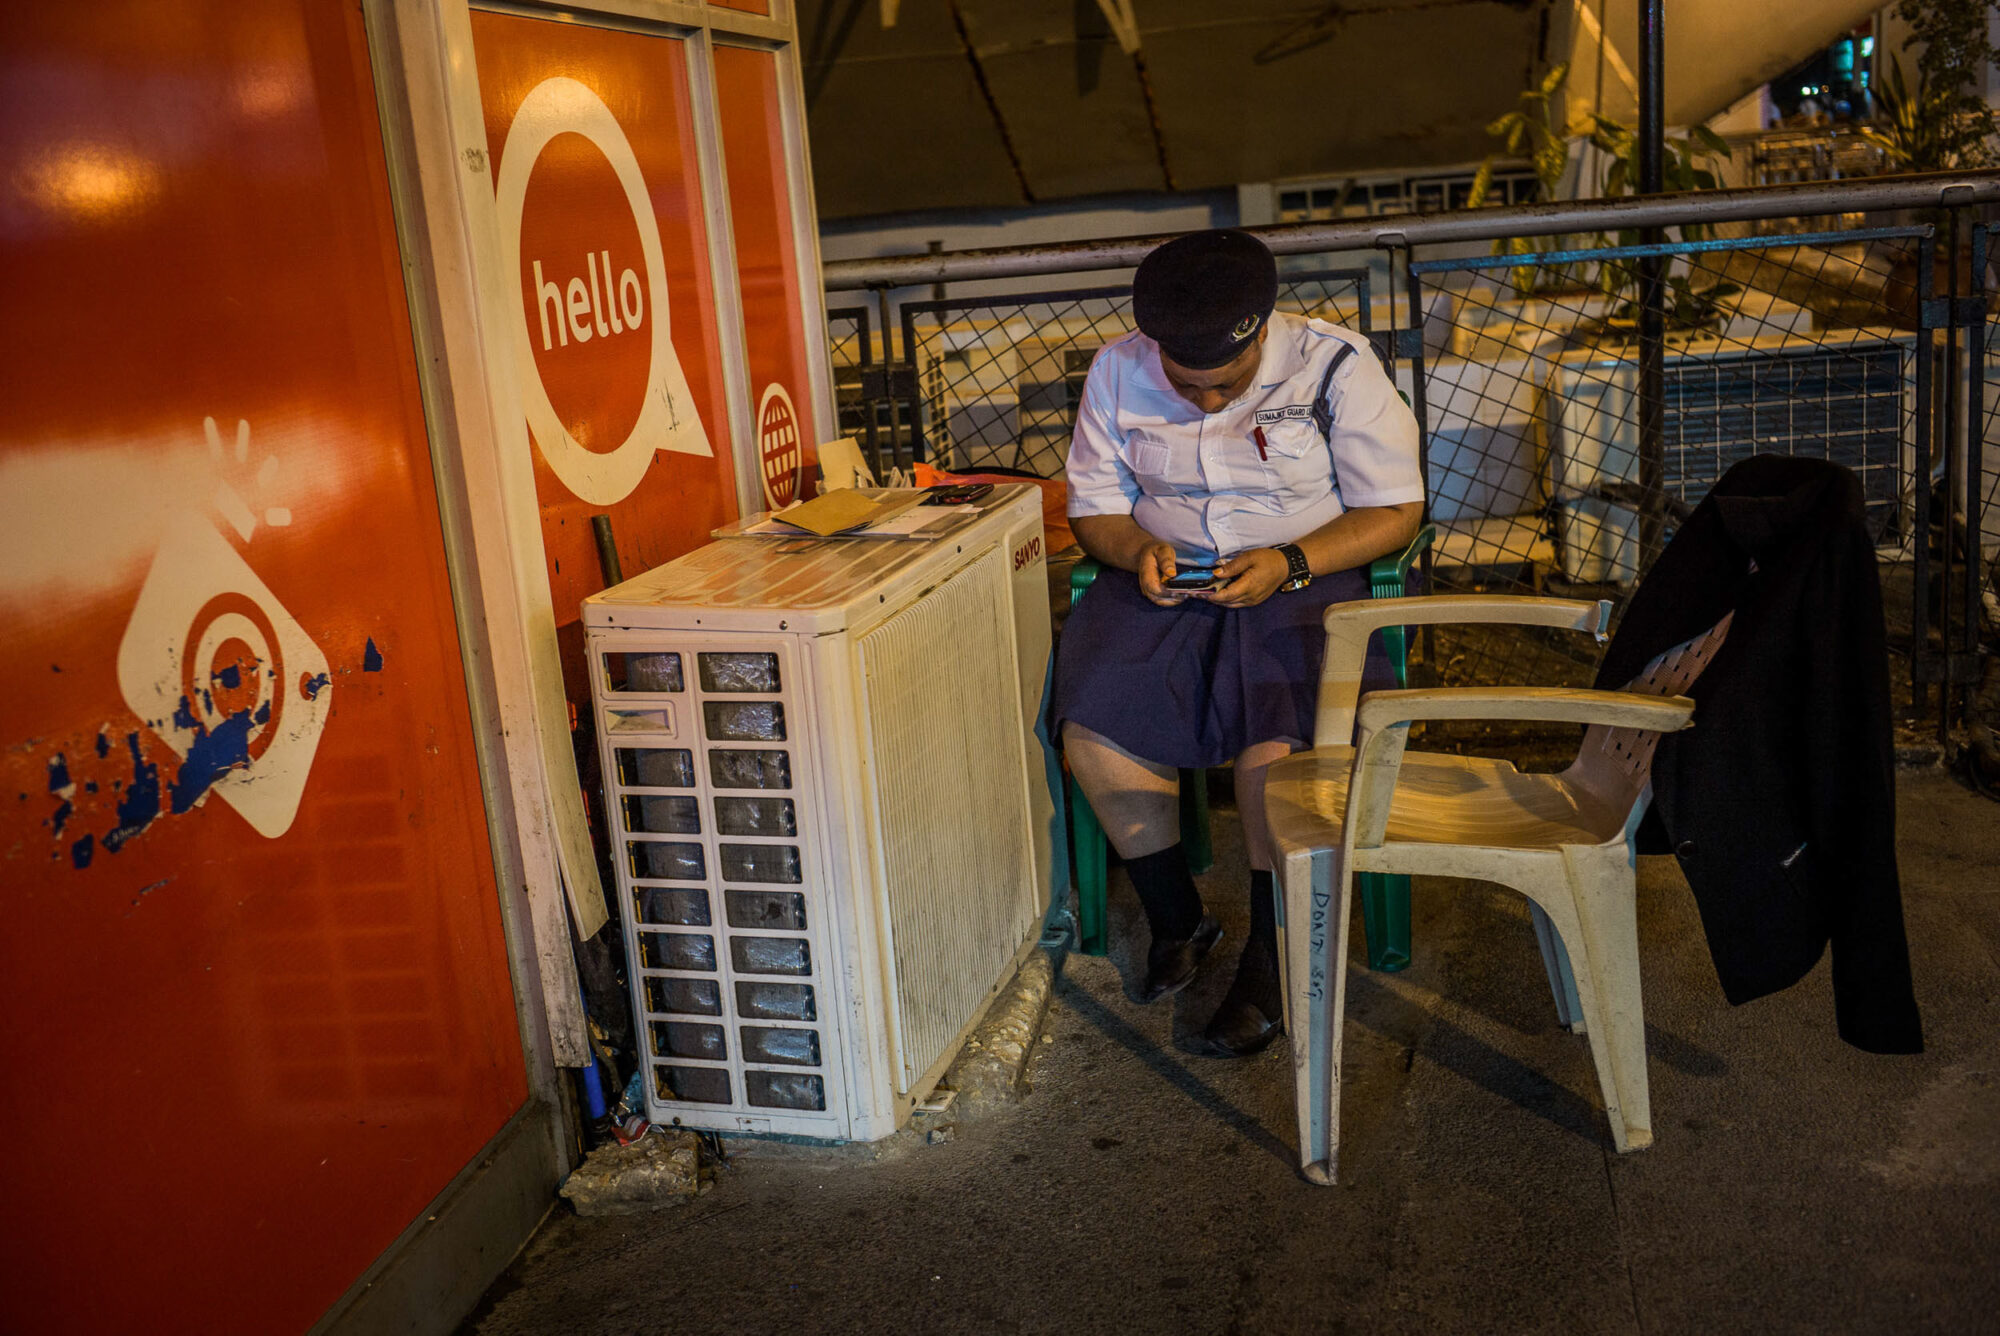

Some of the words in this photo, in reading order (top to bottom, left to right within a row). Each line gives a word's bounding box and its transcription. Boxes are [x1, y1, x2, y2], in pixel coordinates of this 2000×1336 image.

[533, 250, 643, 351] hello
[1287, 408, 1306, 416] GUARD
[1015, 536, 1040, 571] SANYO
